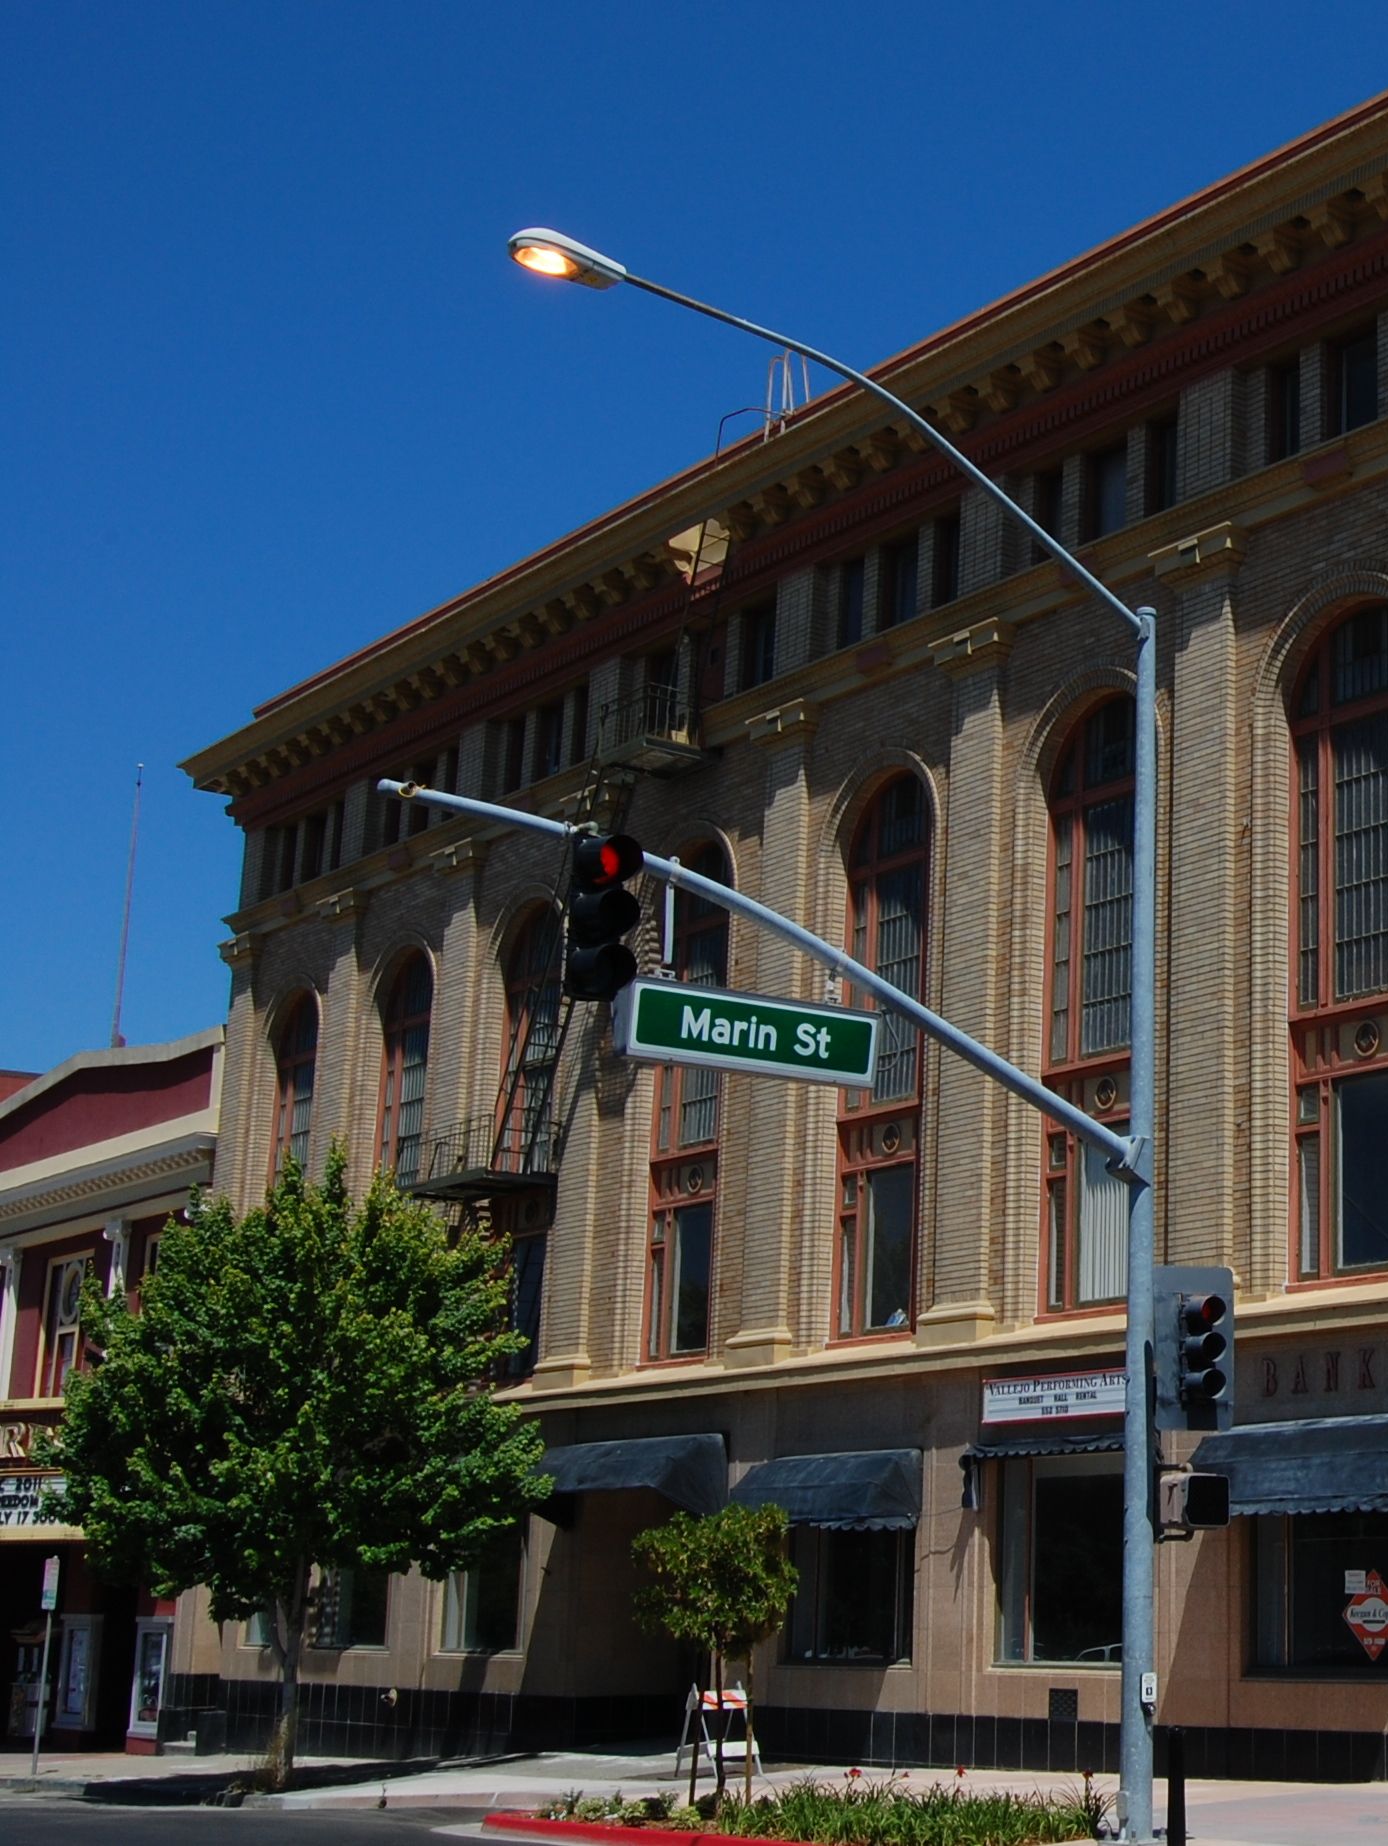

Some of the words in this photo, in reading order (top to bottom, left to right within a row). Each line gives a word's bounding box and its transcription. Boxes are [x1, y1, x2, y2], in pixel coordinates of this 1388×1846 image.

[680, 1005, 778, 1051] Marin
[794, 1022, 831, 1060] St
[1262, 1348, 1377, 1398] BANK
[988, 1383, 1030, 1397] VALLEJO
[1033, 1377, 1097, 1393] PERFORMING
[1100, 1374, 1128, 1388] ARTS
[16, 1477, 42, 1493] 2011
[17, 1511, 29, 1525] 17
